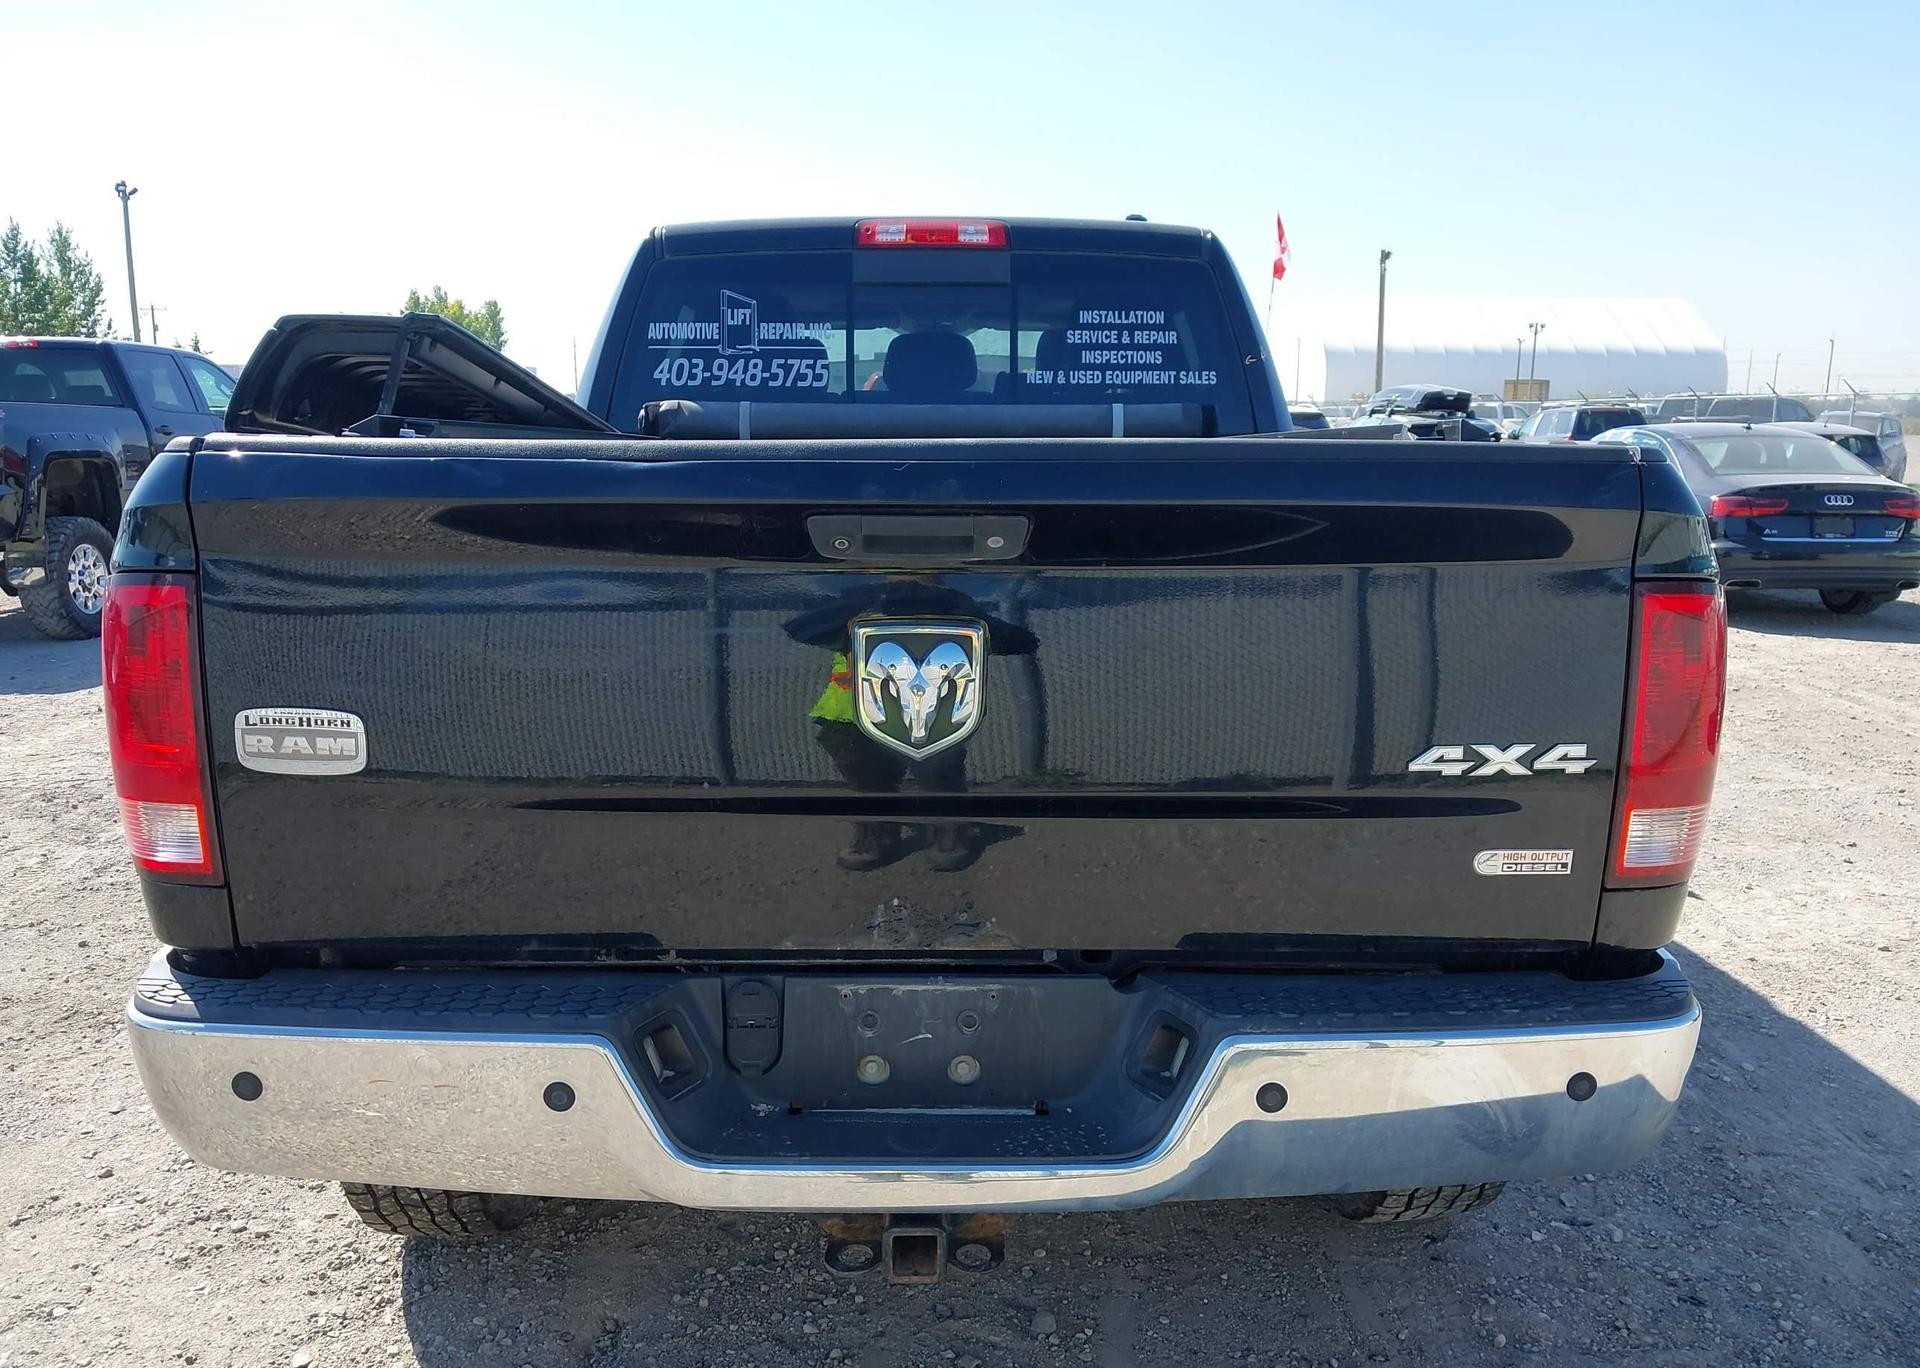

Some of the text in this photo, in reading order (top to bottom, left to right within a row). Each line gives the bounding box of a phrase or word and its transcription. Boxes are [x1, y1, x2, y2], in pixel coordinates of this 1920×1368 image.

[727, 308, 752, 325] LIFT
[1079, 310, 1165, 324] INSTALLATION
[648, 322, 720, 340] AUTOMOTIVE
[759, 322, 806, 340] REPAIR
[1066, 330, 1178, 344] SERVICE & REPAIR
[1081, 350, 1163, 364] INSPECTIONS
[653, 357, 830, 388] 403-948-5755
[1026, 370, 1218, 385] NEW & USED EQUIPMENT SALES
[244, 734, 357, 756] RAM
[1408, 743, 1599, 776] 4X4
[1502, 852, 1570, 862] HIGH OUTPUT
[1502, 863, 1568, 873] DIESEL
